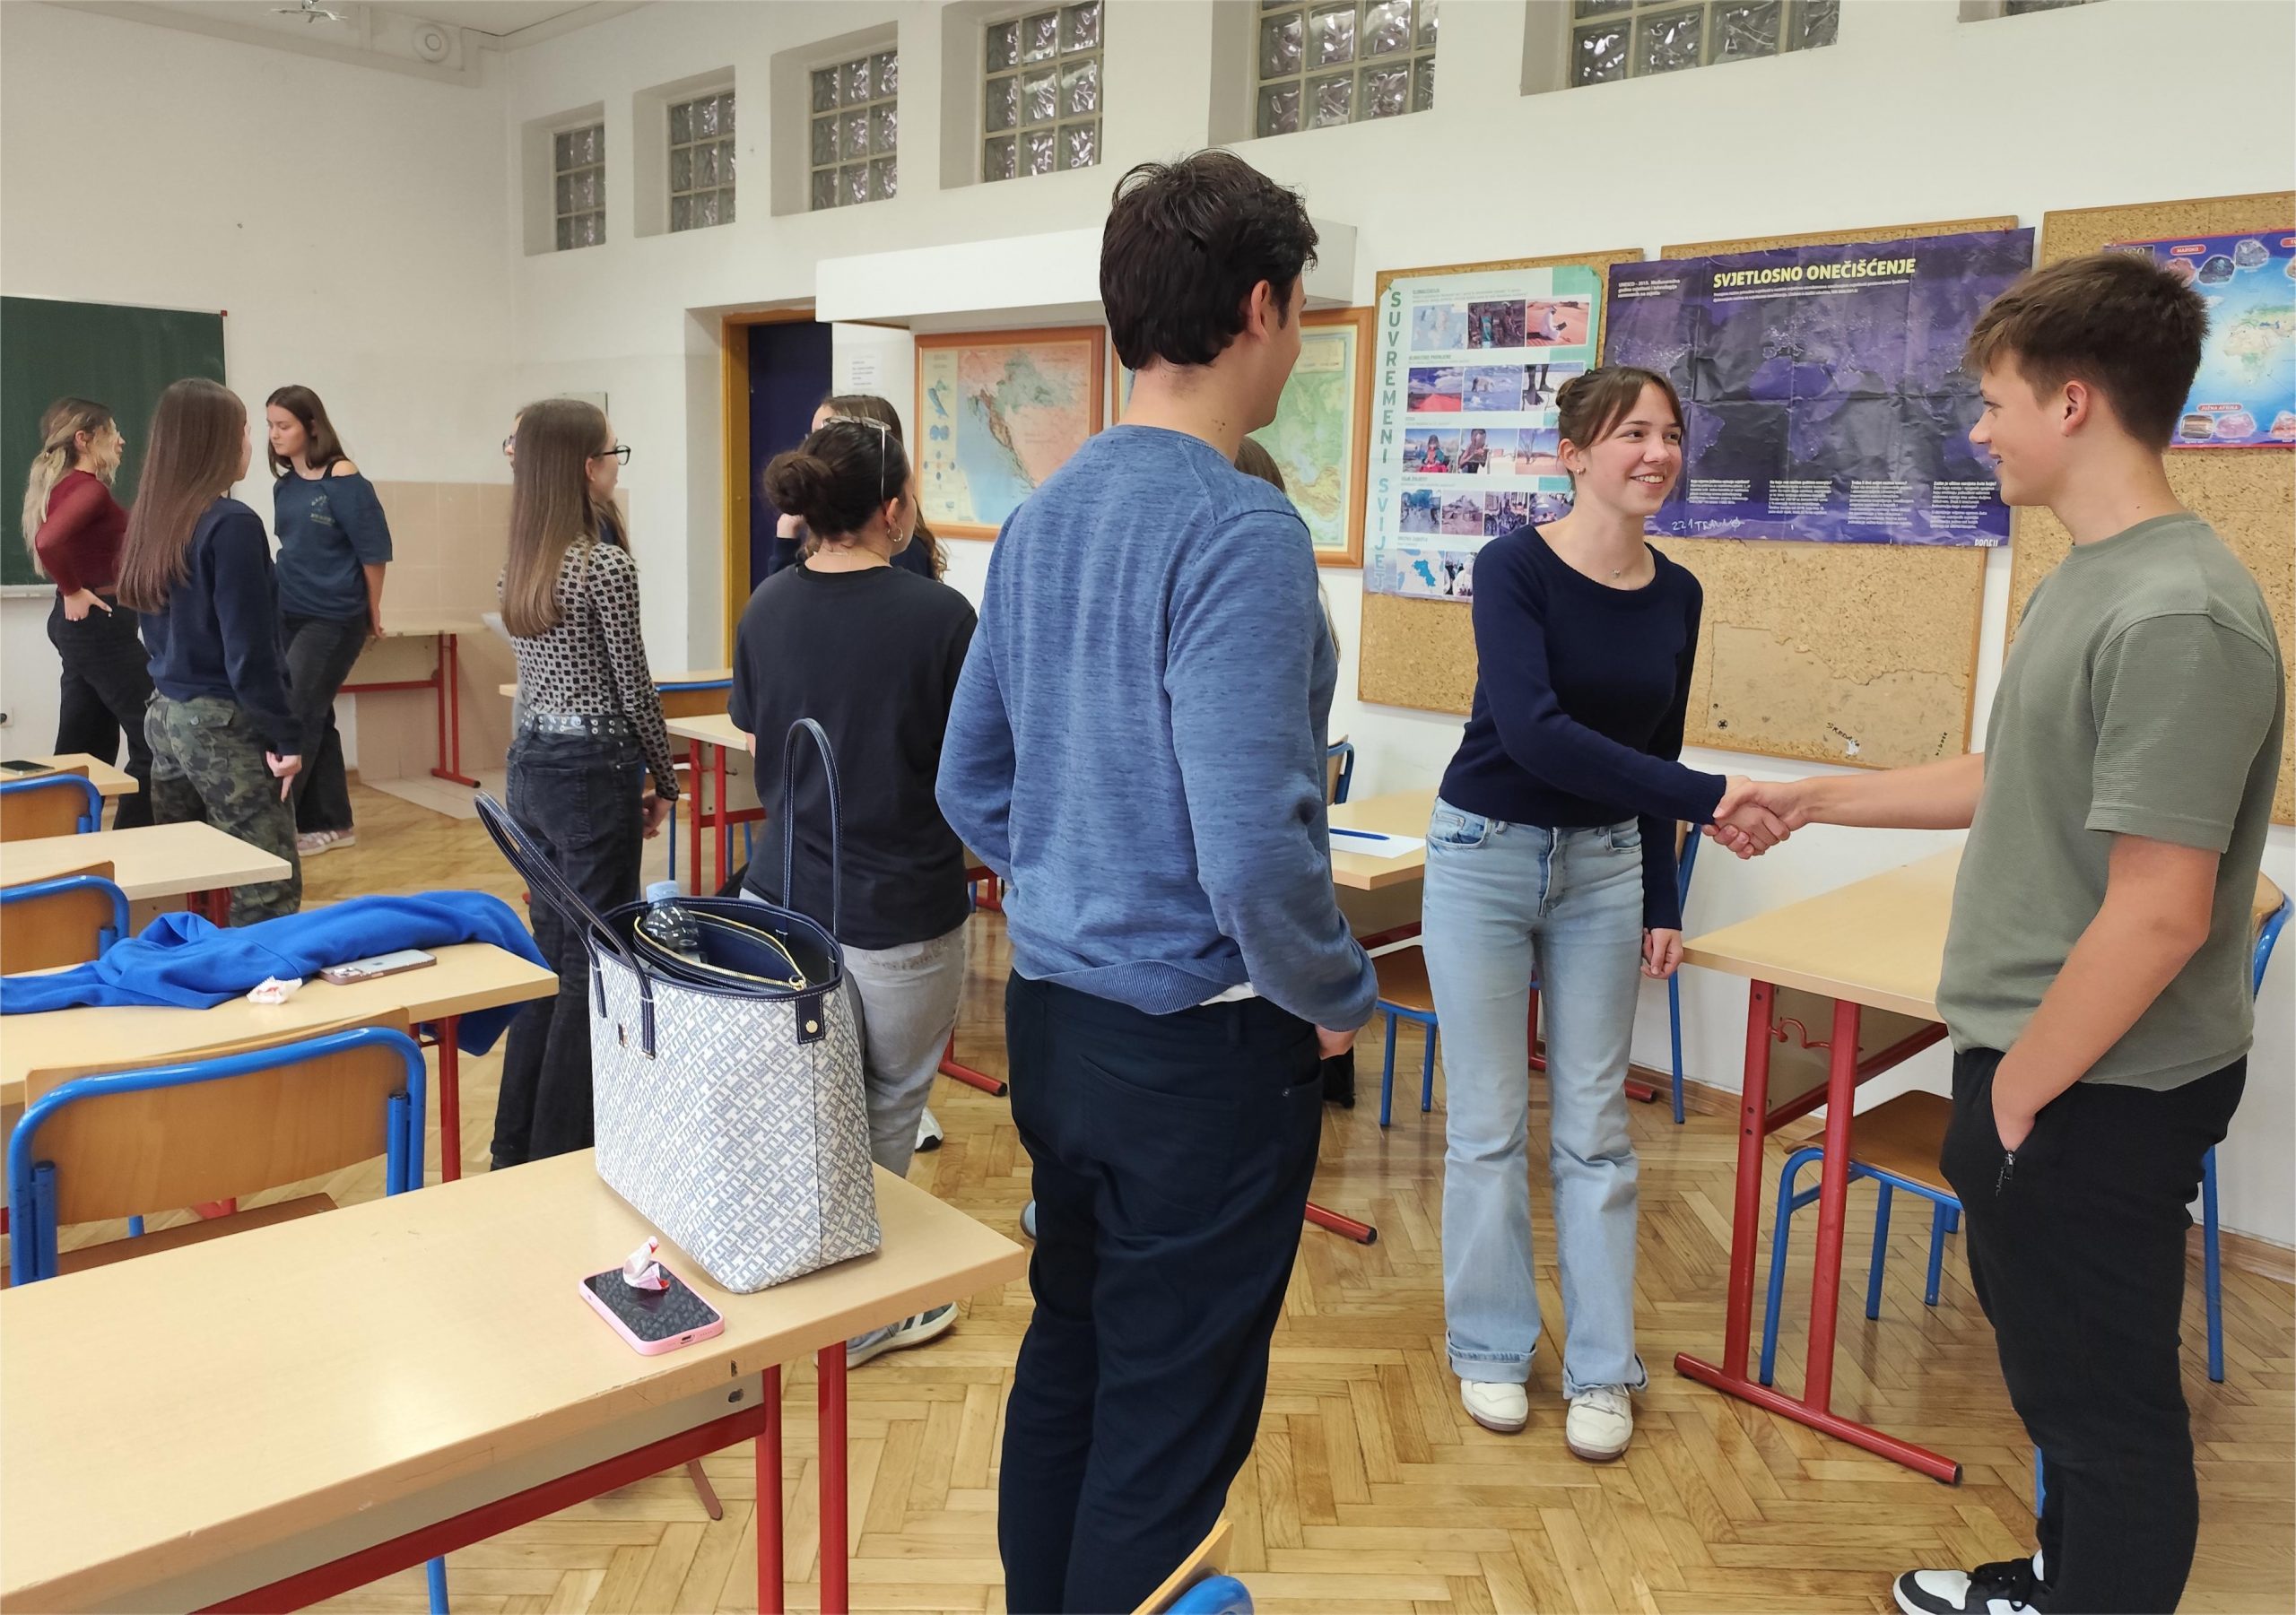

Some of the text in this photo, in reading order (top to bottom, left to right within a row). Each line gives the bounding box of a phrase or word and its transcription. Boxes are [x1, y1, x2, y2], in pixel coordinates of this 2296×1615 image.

[1713, 258, 1917, 289] SVJETLOSNO ONEČIŠĆENJE
[1374, 291, 1402, 591] SUVREMENI SVIJET
